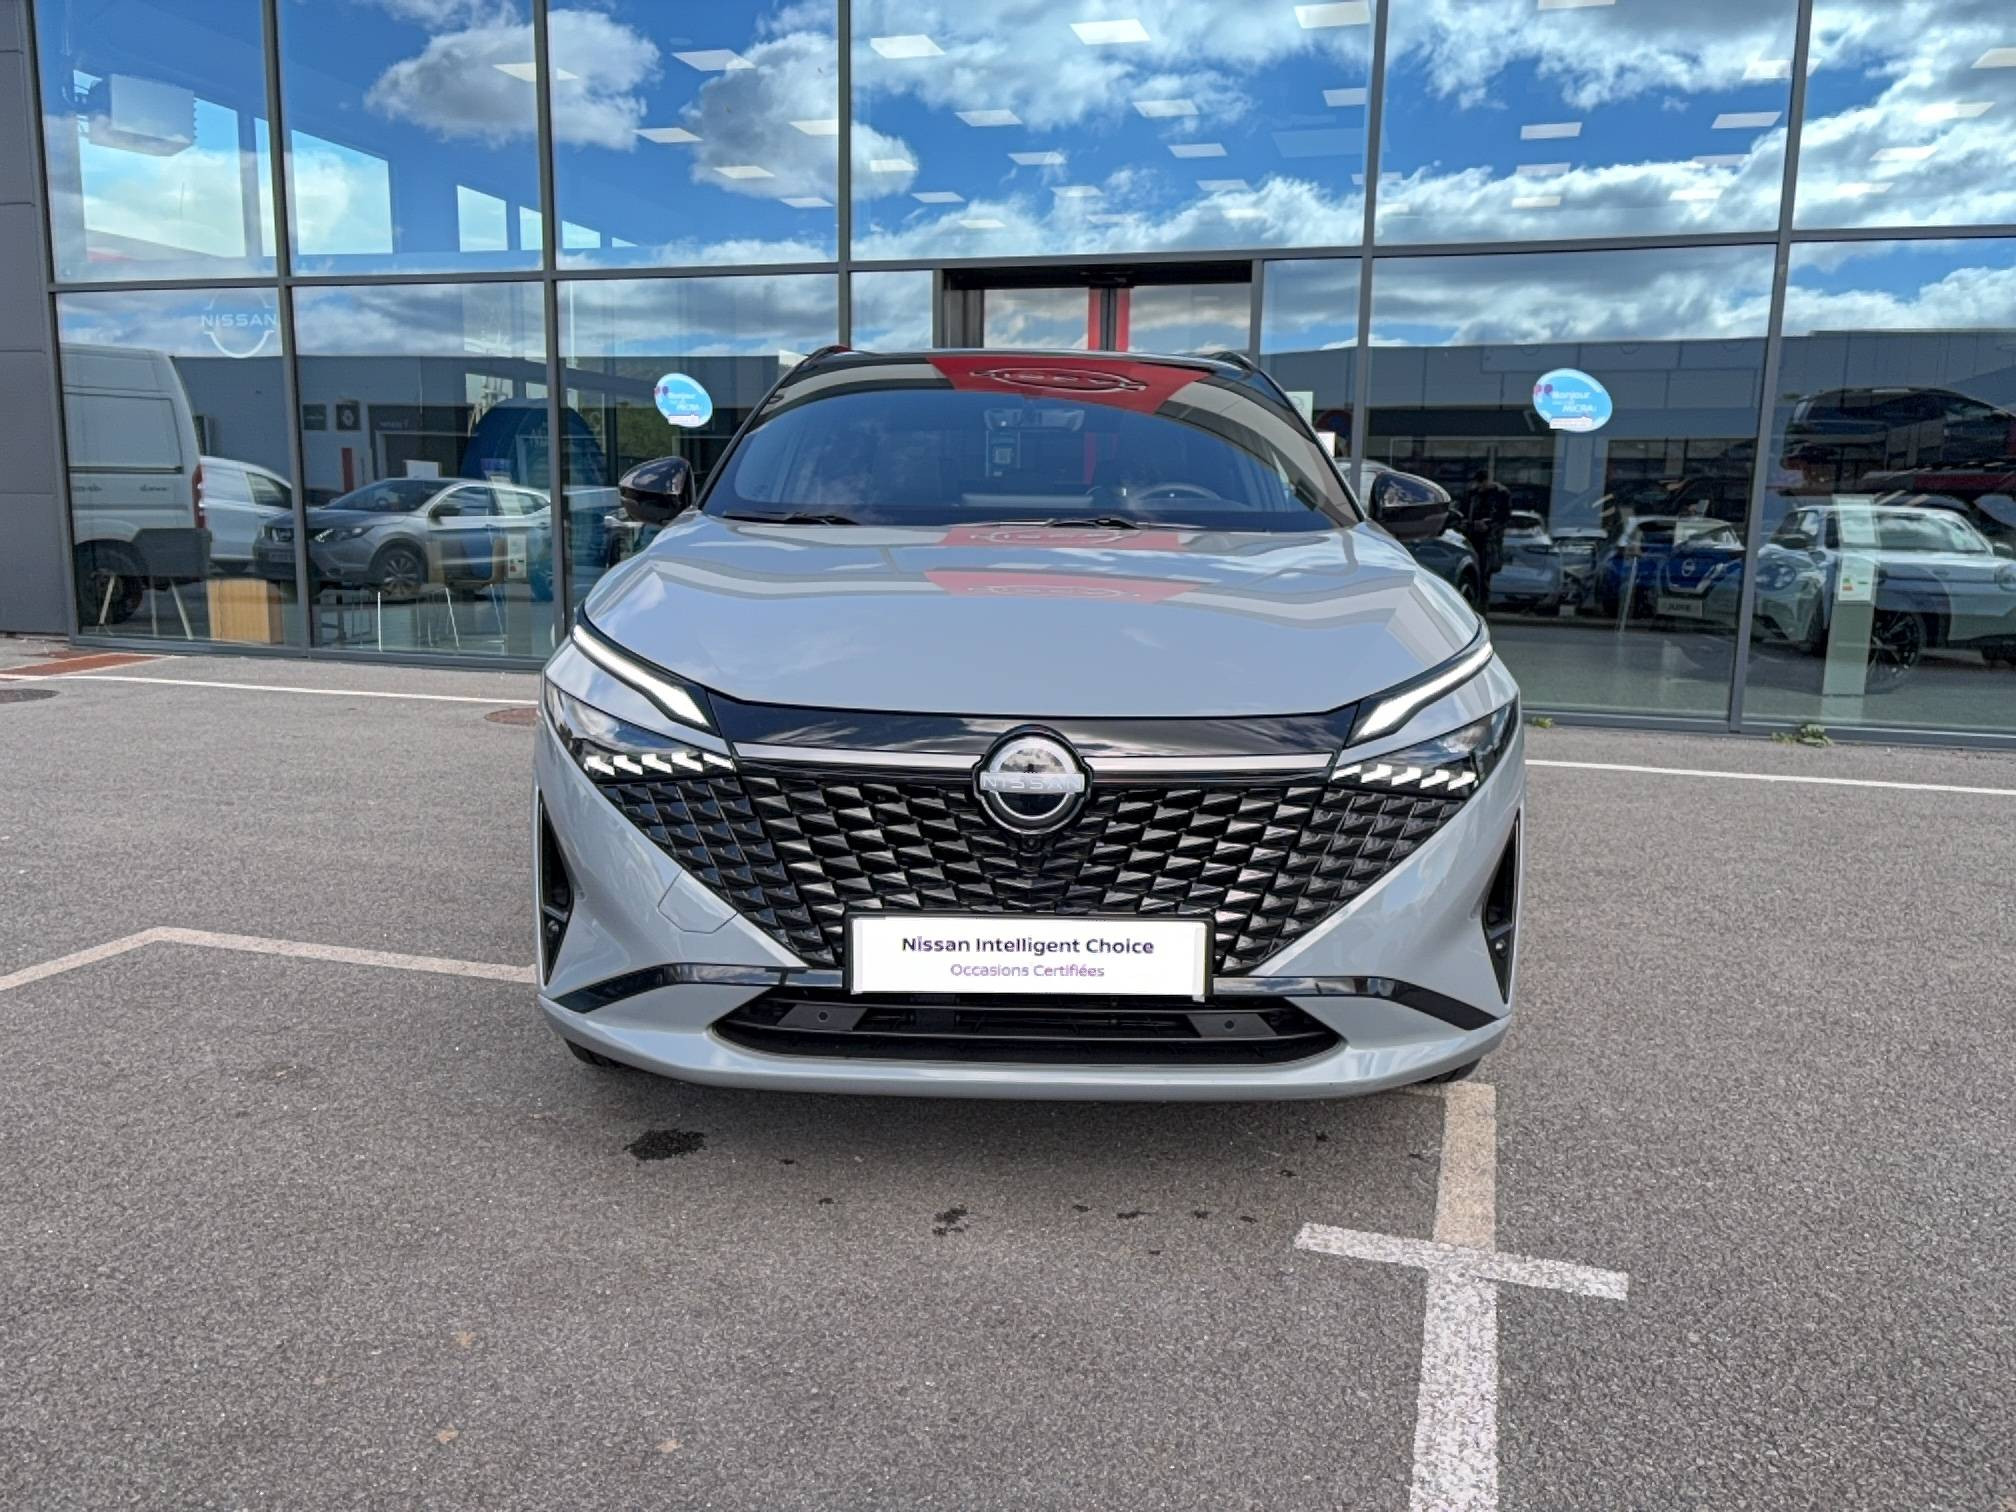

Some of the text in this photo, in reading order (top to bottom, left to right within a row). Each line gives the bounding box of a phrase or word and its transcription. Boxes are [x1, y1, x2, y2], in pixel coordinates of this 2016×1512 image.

[201, 313, 277, 327] NISSAN
[983, 776, 1081, 790] NISSAN
[902, 936, 1154, 956] Nissan Intelligent Choice
[951, 964, 1104, 977] Occasions Certifiées
